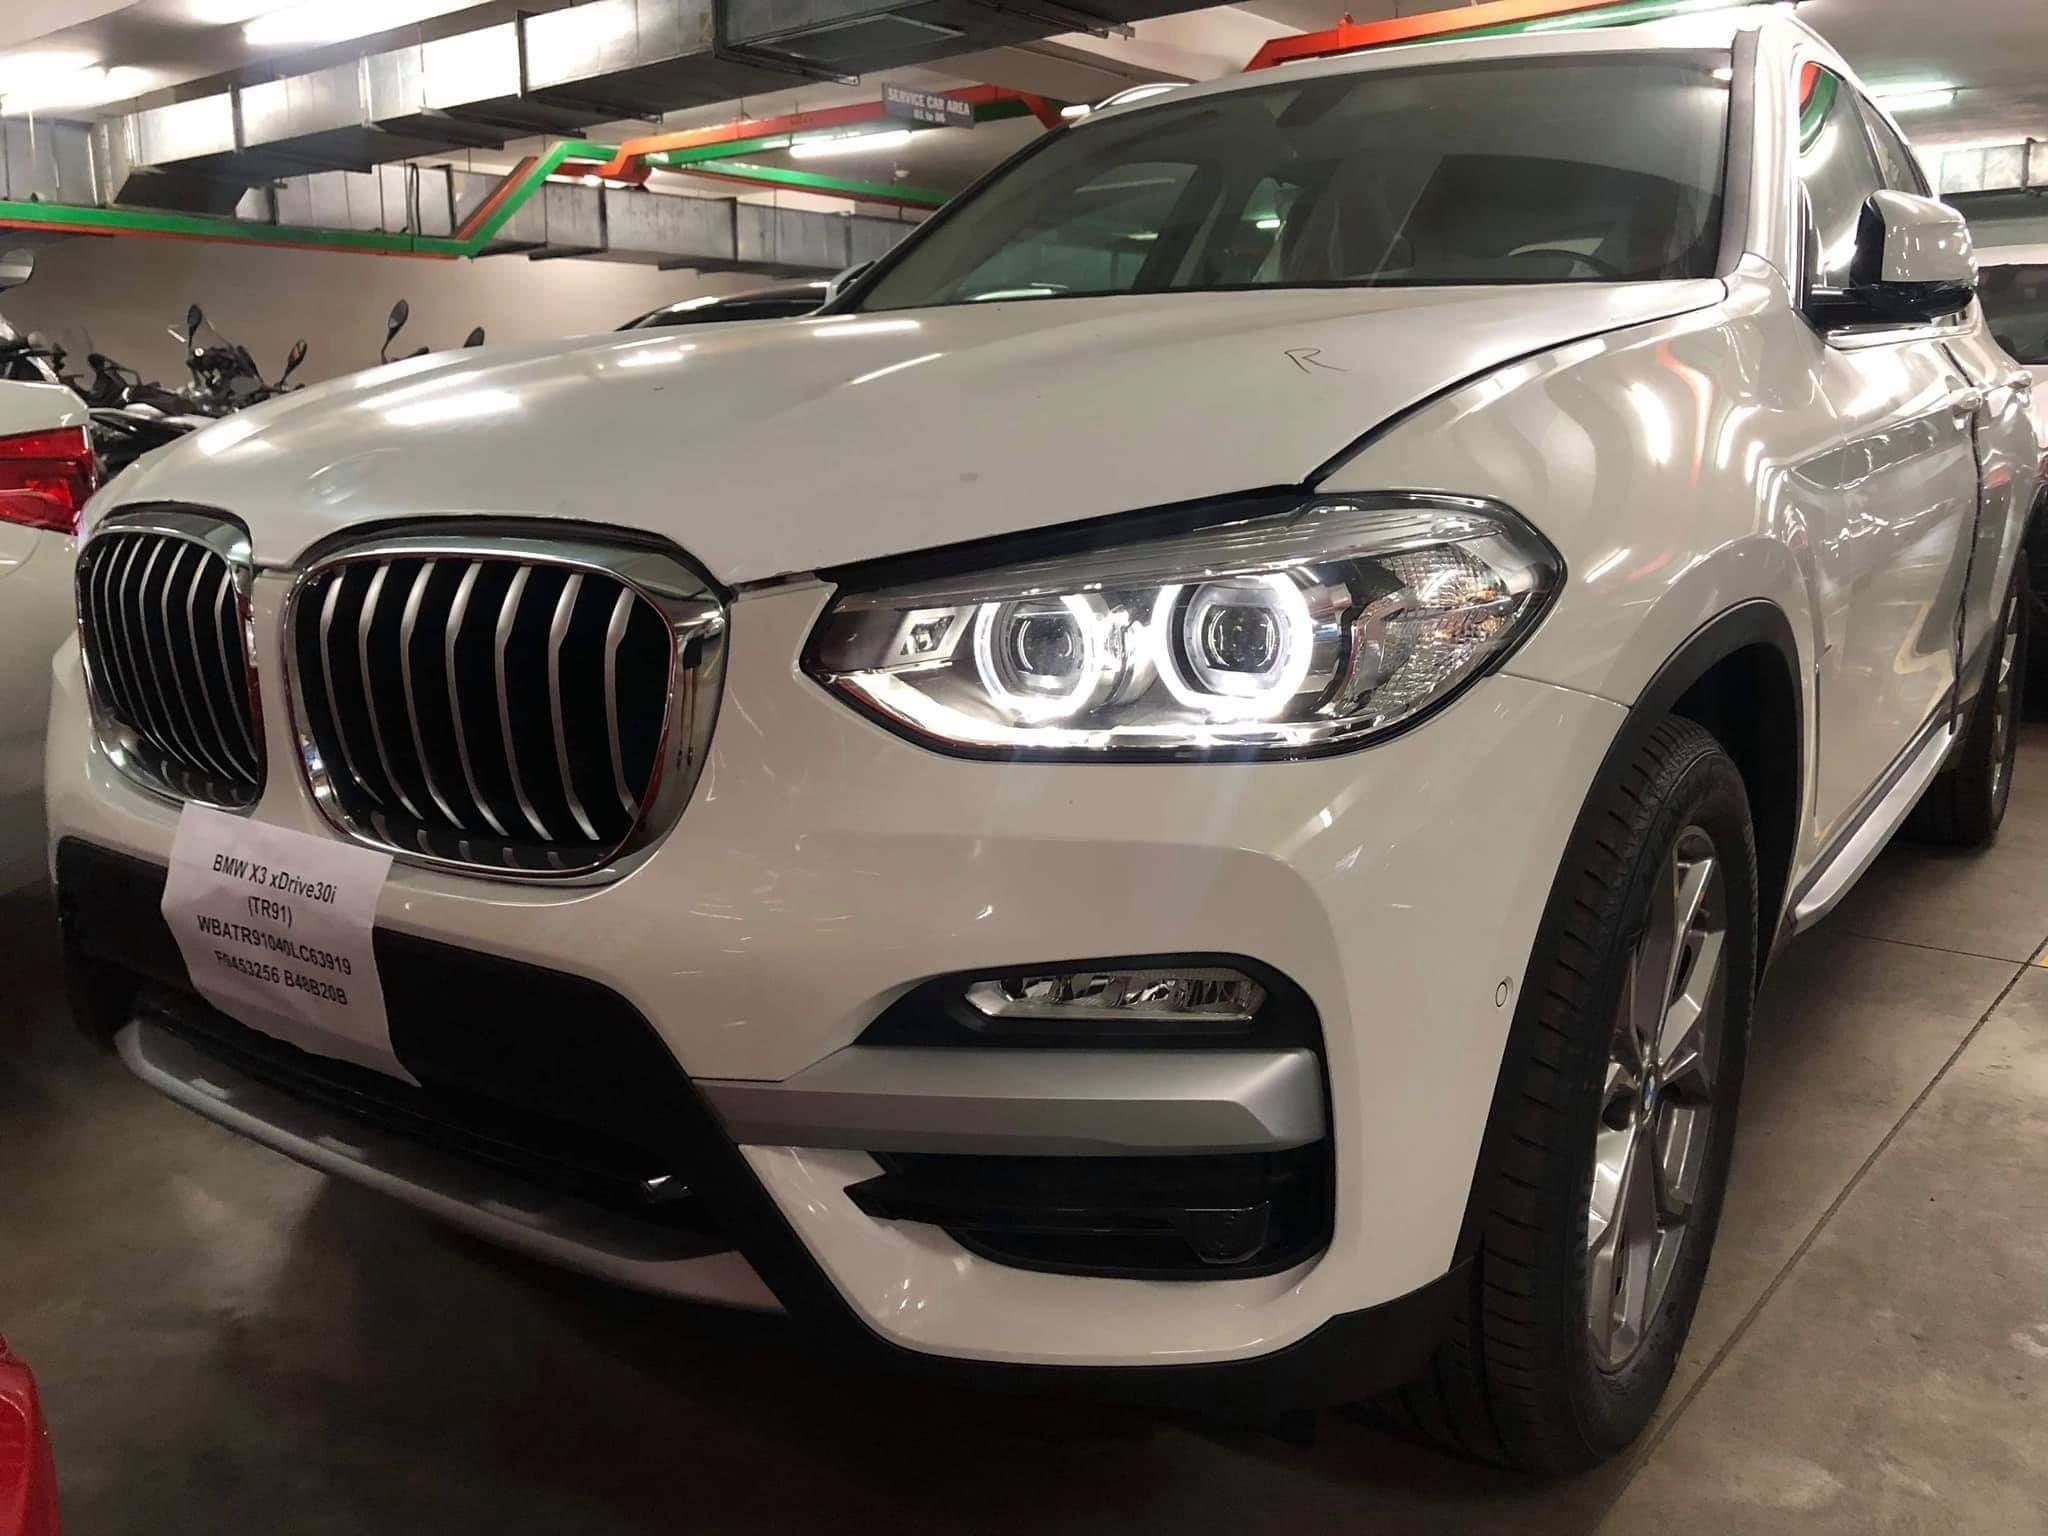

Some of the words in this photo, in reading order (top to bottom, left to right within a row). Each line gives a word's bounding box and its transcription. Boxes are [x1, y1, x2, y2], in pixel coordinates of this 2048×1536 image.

[888, 87, 926, 107] SERVICE
[927, 95, 945, 111] CAR
[946, 100, 970, 115] AREA
[213, 854, 249, 880] BMW
[249, 863, 267, 884] X3
[269, 872, 337, 905] xDrive30i
[247, 896, 293, 928] (TR91)
[197, 914, 352, 976] WBATR91040LC63919
